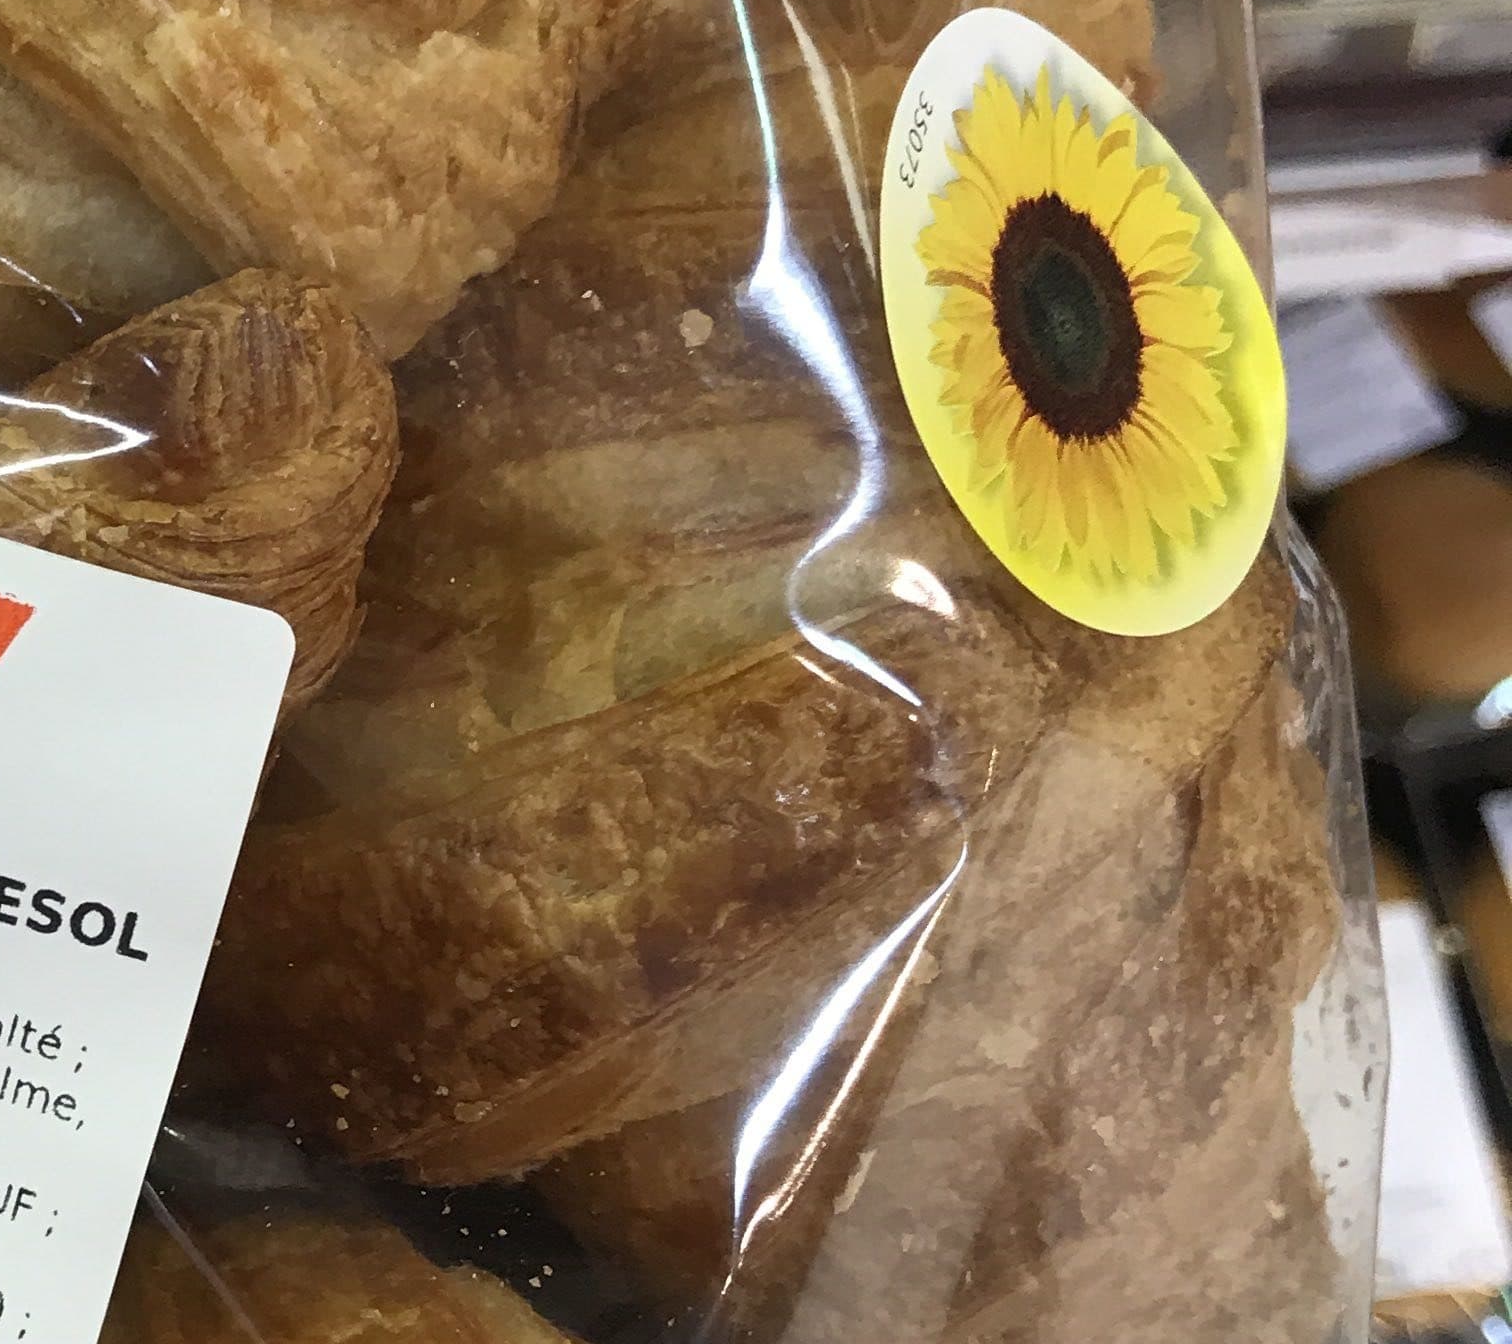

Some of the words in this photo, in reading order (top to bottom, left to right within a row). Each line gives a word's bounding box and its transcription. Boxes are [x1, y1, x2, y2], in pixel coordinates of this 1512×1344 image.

[899, 90, 934, 189] 35073
[73, 1045, 88, 1074] ;
[44, 1209, 58, 1238] ;
[17, 1312, 31, 1340] ;
